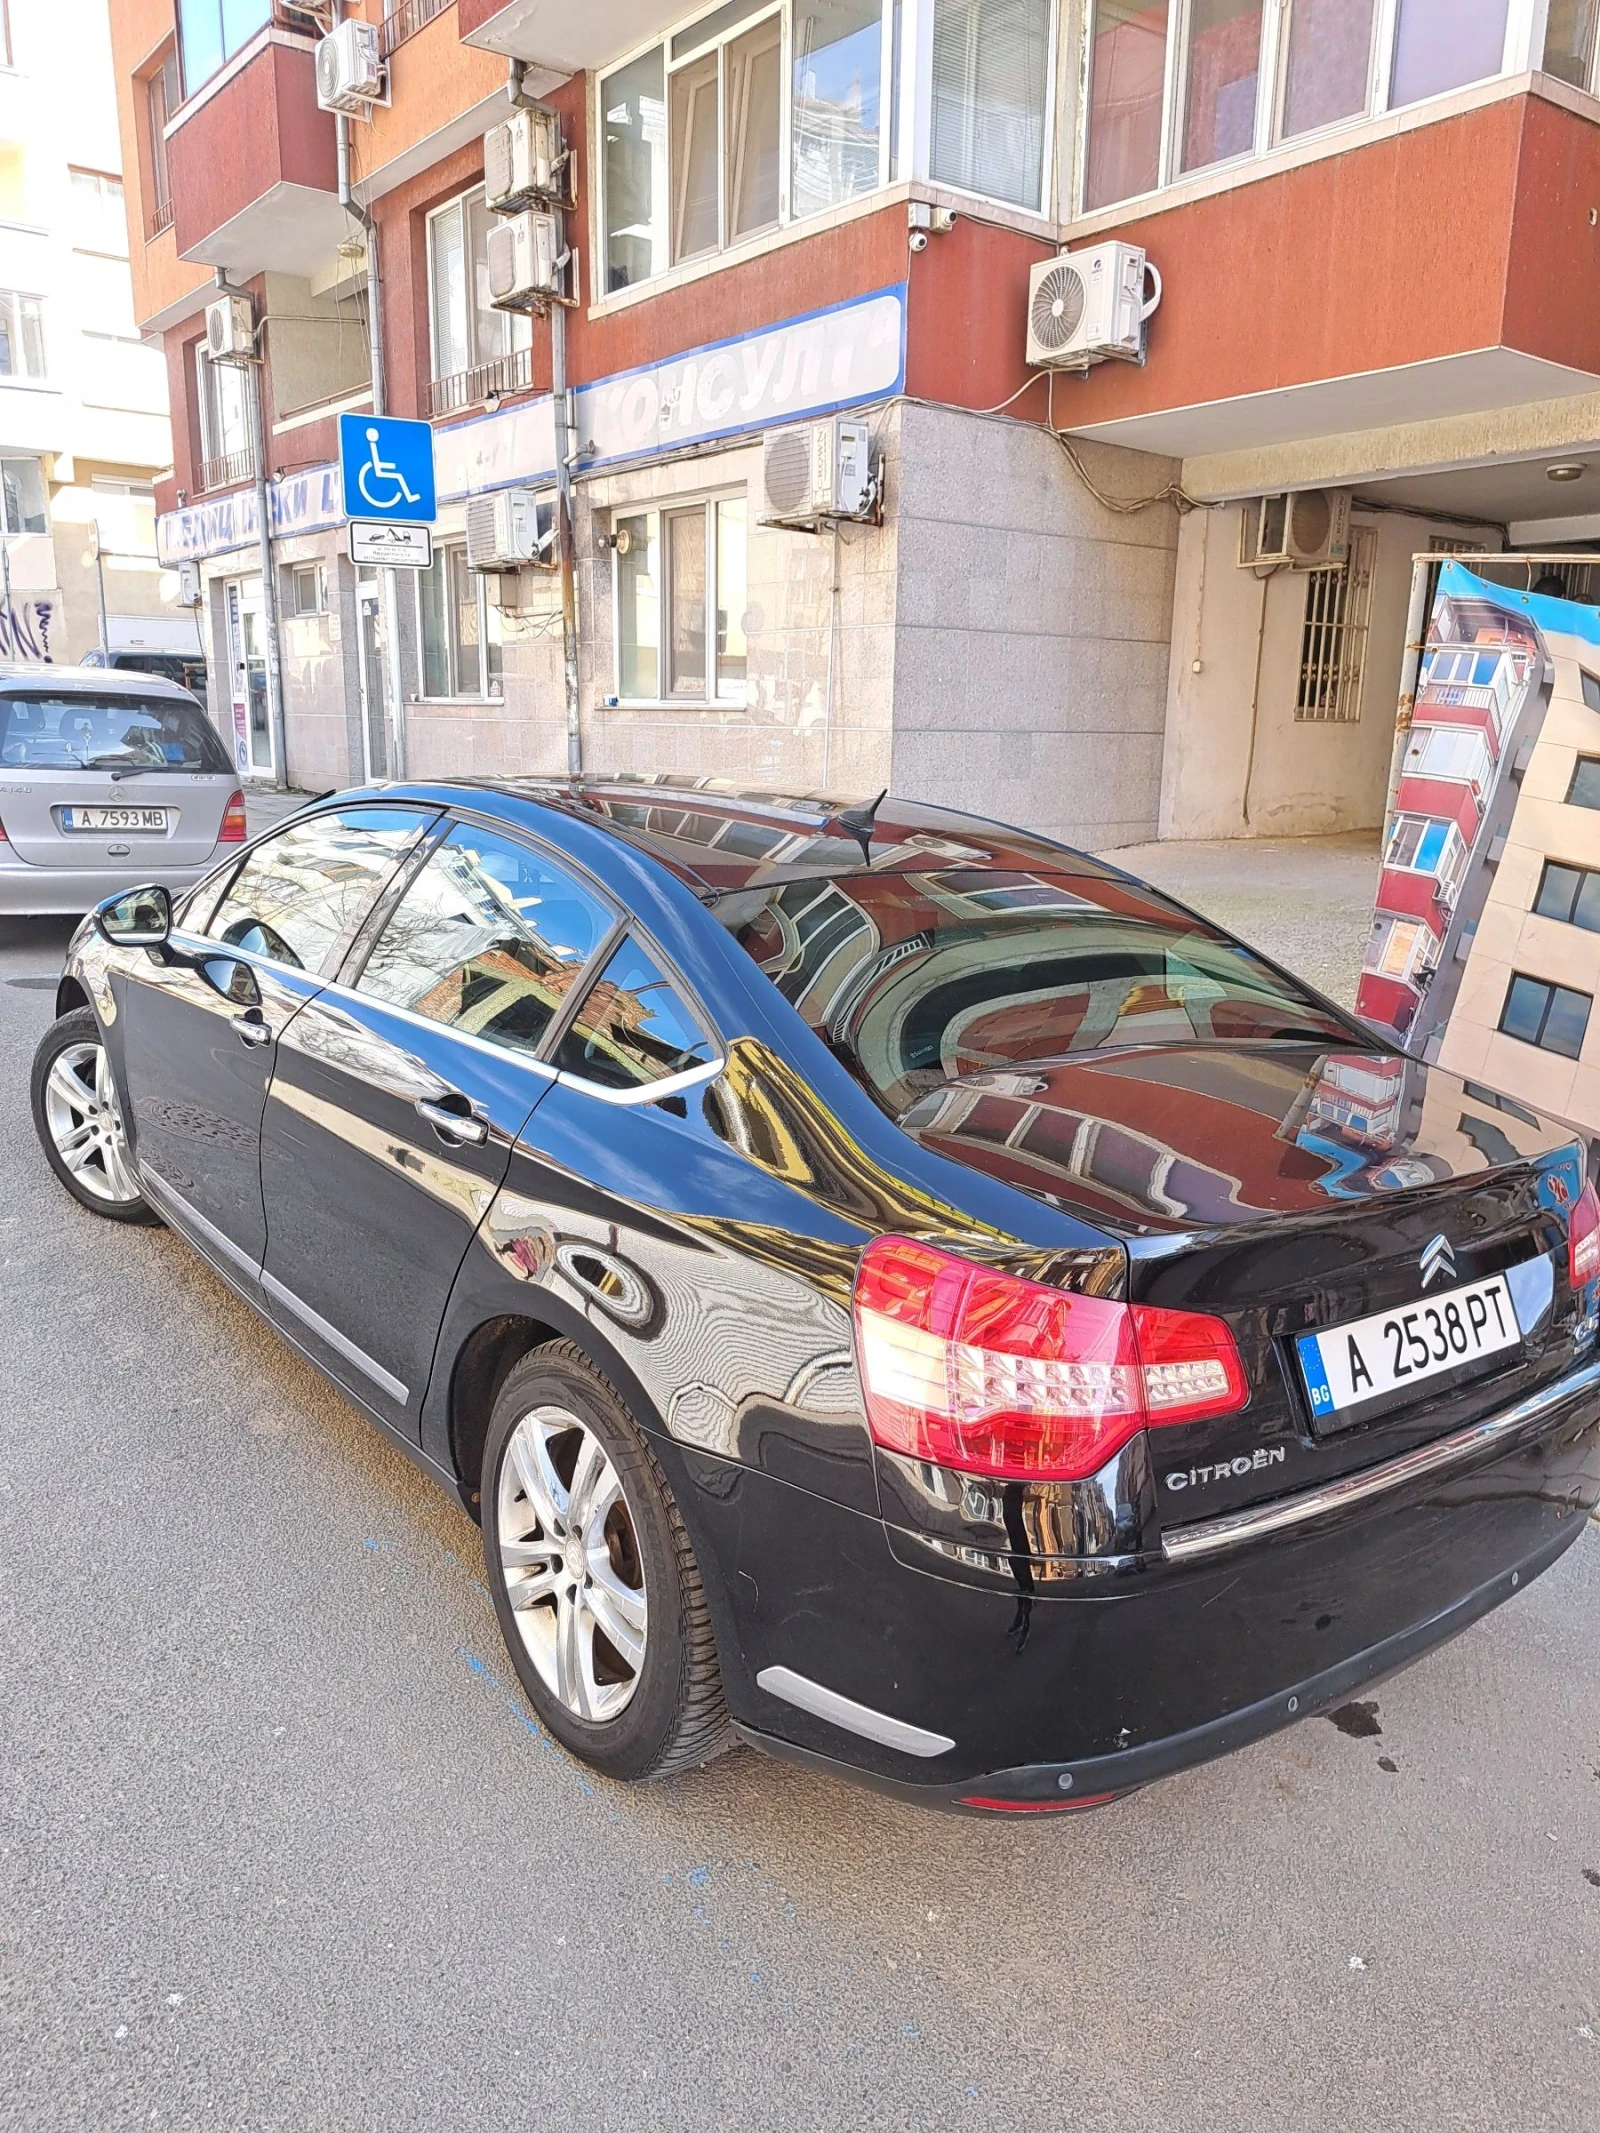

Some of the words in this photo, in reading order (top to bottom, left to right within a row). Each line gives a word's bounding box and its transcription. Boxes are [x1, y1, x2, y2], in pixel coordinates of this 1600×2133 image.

[81, 810, 92, 826] A
[1347, 1334, 1374, 1393] A
[1311, 1384, 1330, 1406] BG
